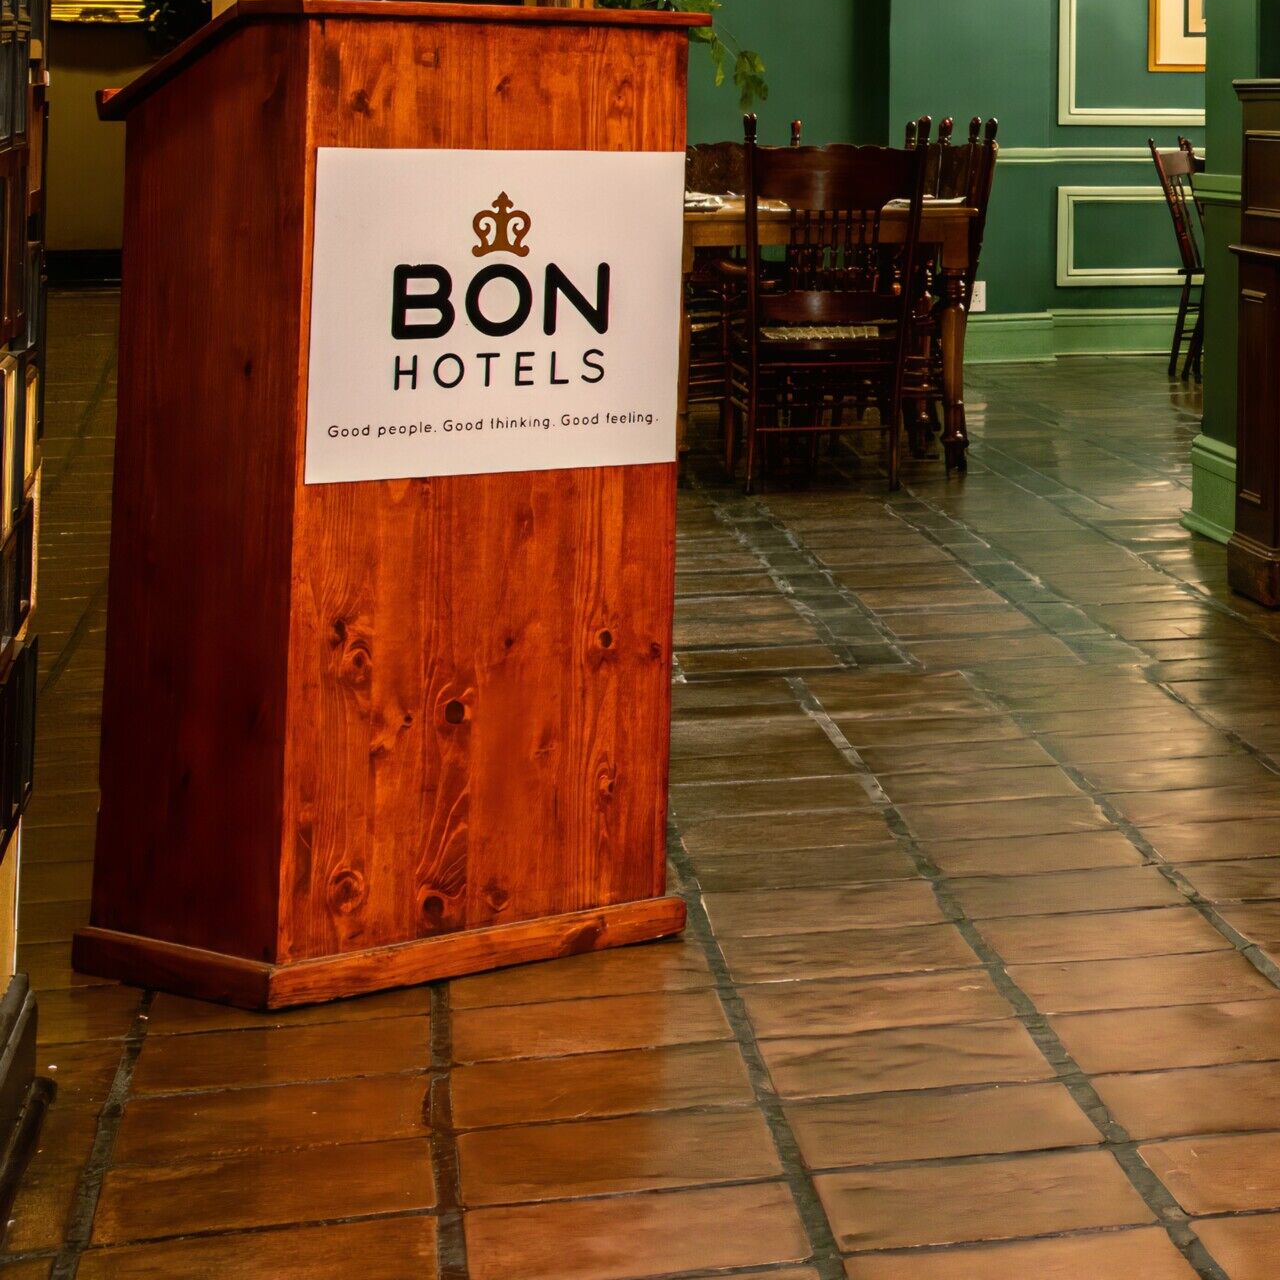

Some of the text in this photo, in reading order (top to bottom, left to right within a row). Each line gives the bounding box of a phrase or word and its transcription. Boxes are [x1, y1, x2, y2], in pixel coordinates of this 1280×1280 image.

[391, 262, 610, 339] BON
[394, 348, 605, 391] HOTELS
[328, 411, 659, 438] Good people. Good thinking. Good feeling.
